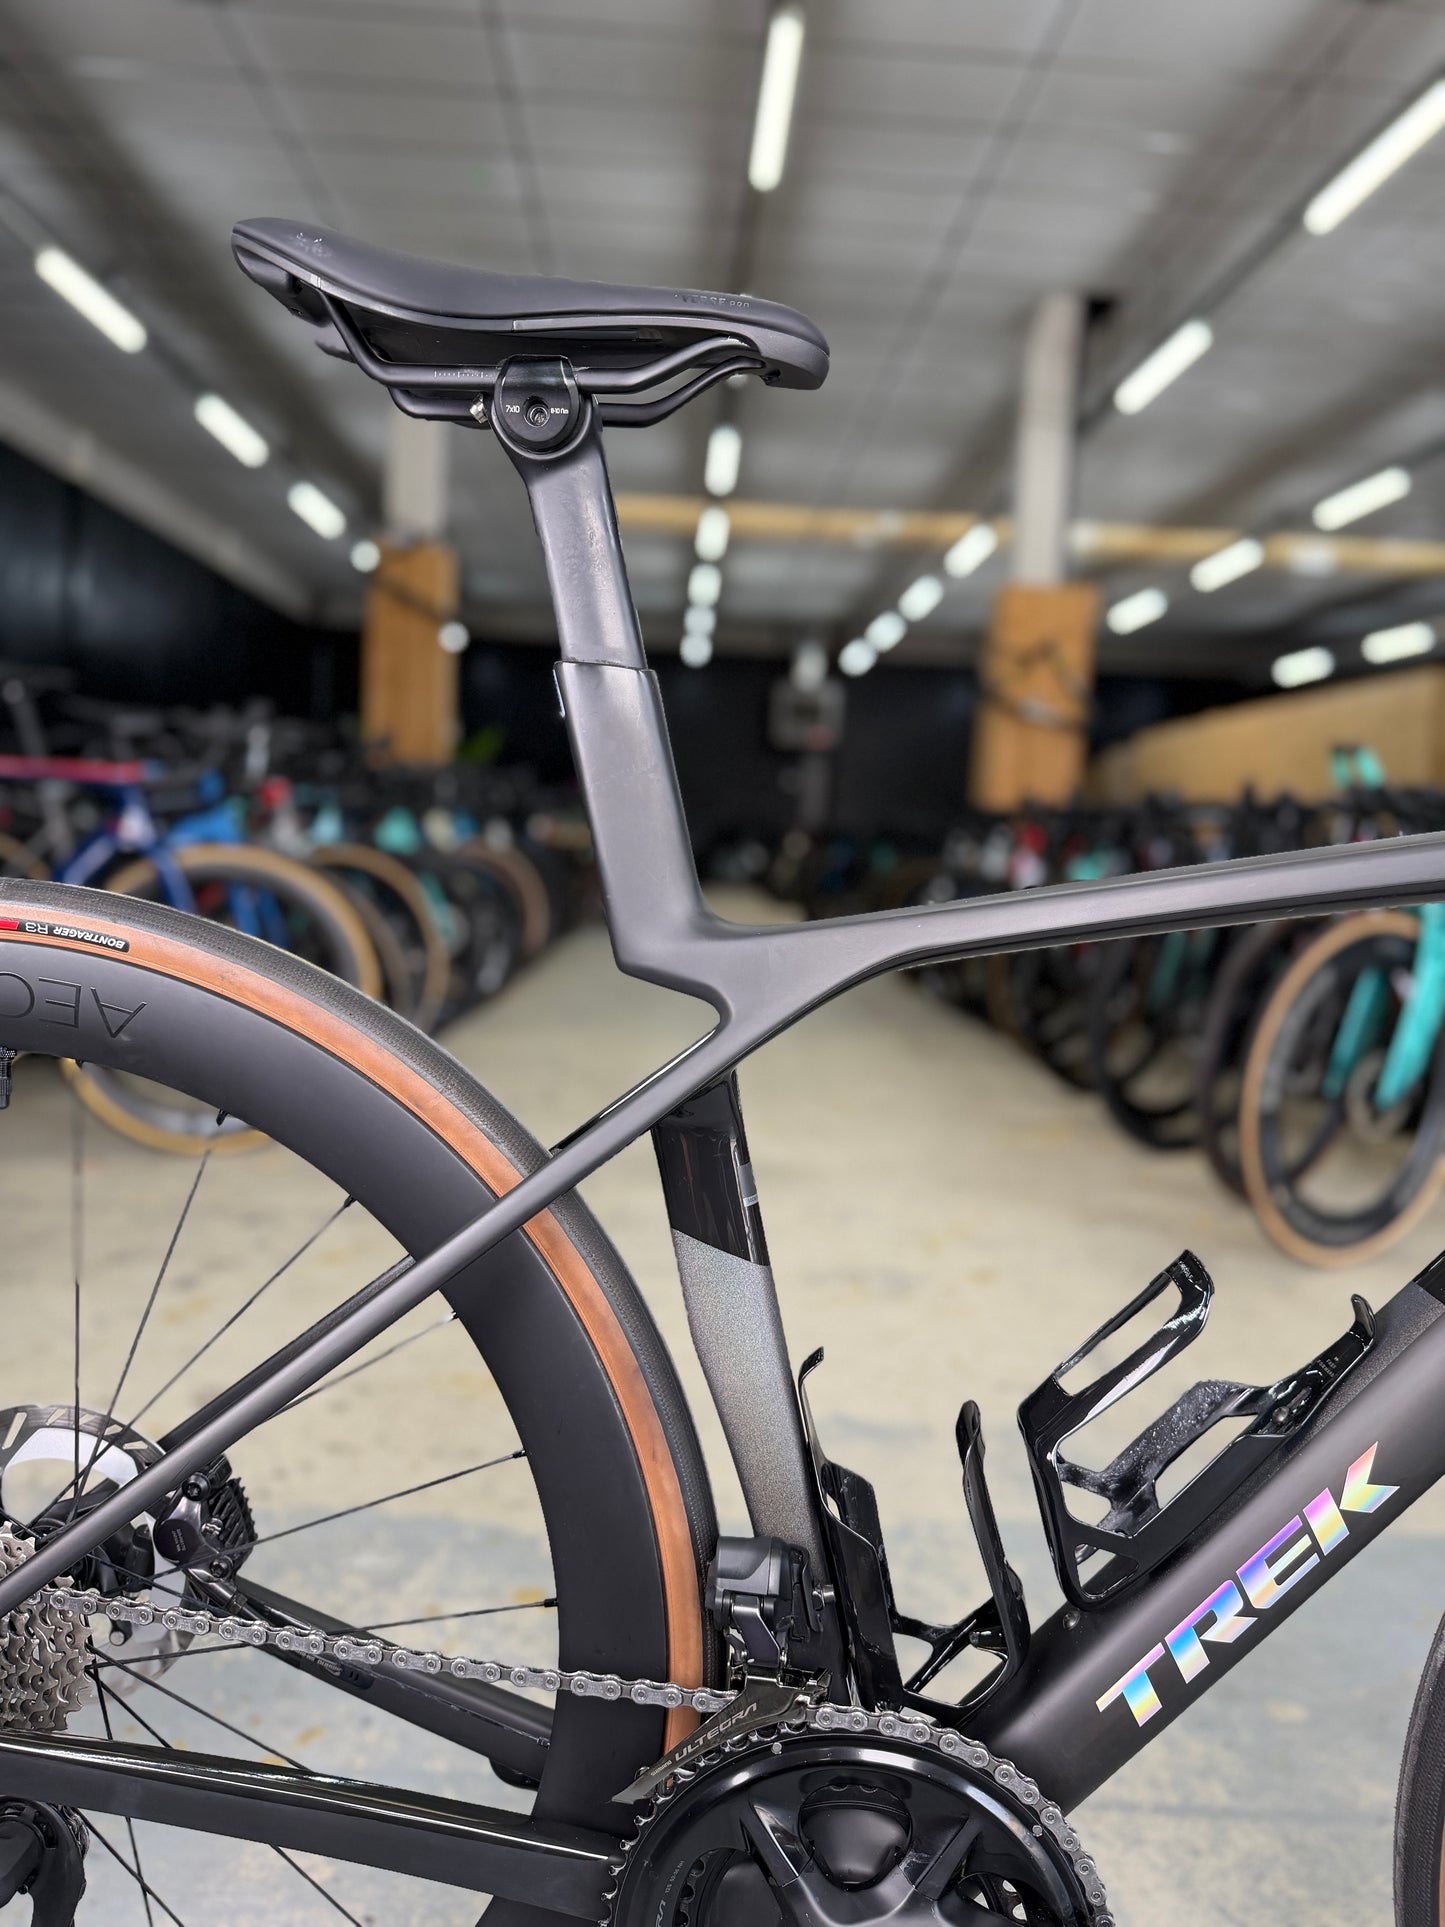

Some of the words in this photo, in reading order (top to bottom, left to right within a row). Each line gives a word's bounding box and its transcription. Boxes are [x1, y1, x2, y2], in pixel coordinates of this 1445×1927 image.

[505, 405, 520, 413] 7x10
[25, 921, 48, 934] R3
[53, 926, 126, 949] BONTRAGER
[1095, 1441, 1400, 1728] TREK
[675, 1702, 757, 1761] ULTEGRA
